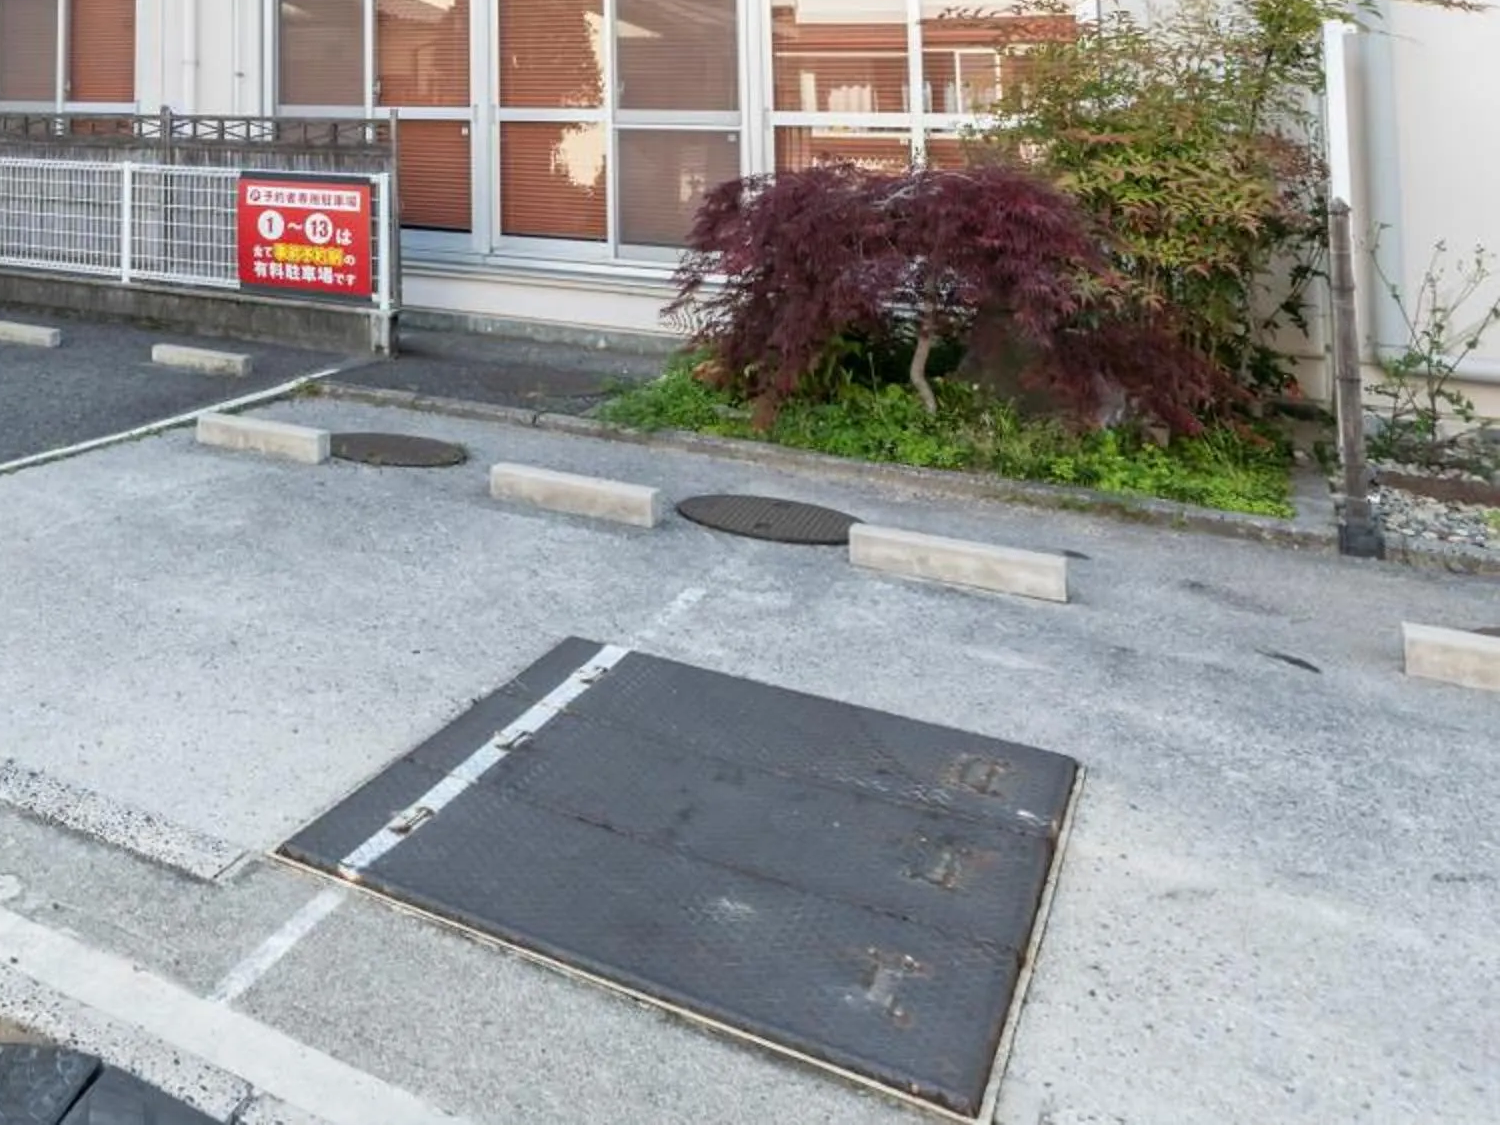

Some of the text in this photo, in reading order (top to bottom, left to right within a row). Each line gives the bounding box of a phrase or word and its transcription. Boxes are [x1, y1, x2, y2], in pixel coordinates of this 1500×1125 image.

[253, 261, 356, 286] 有料駐車場です
